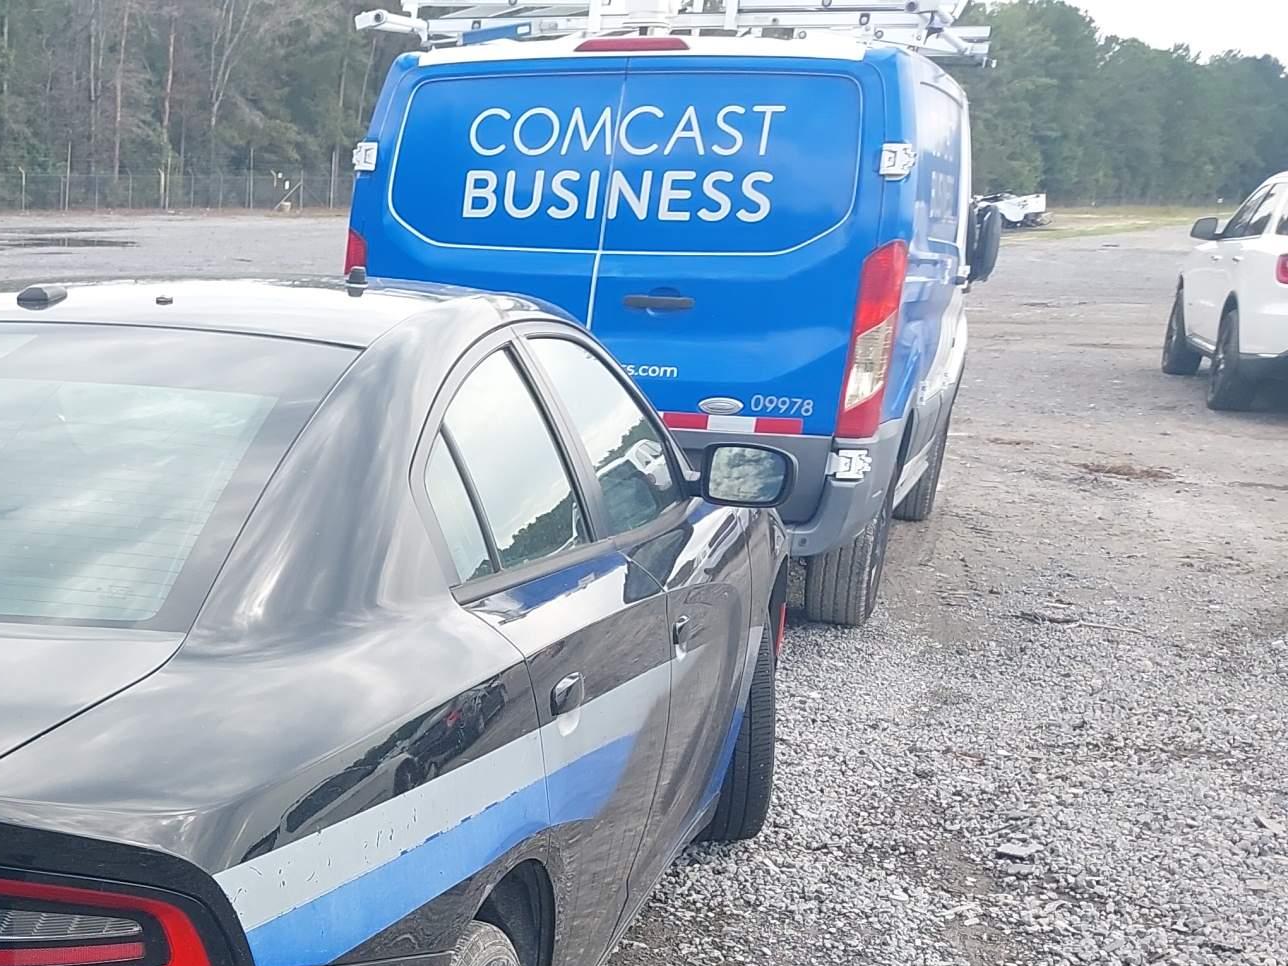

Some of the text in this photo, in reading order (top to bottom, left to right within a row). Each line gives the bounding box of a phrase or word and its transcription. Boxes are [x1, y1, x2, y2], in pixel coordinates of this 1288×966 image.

[469, 105, 787, 156] COMCAST
[462, 170, 775, 222] BUSINESS
[750, 394, 814, 416] 09978
